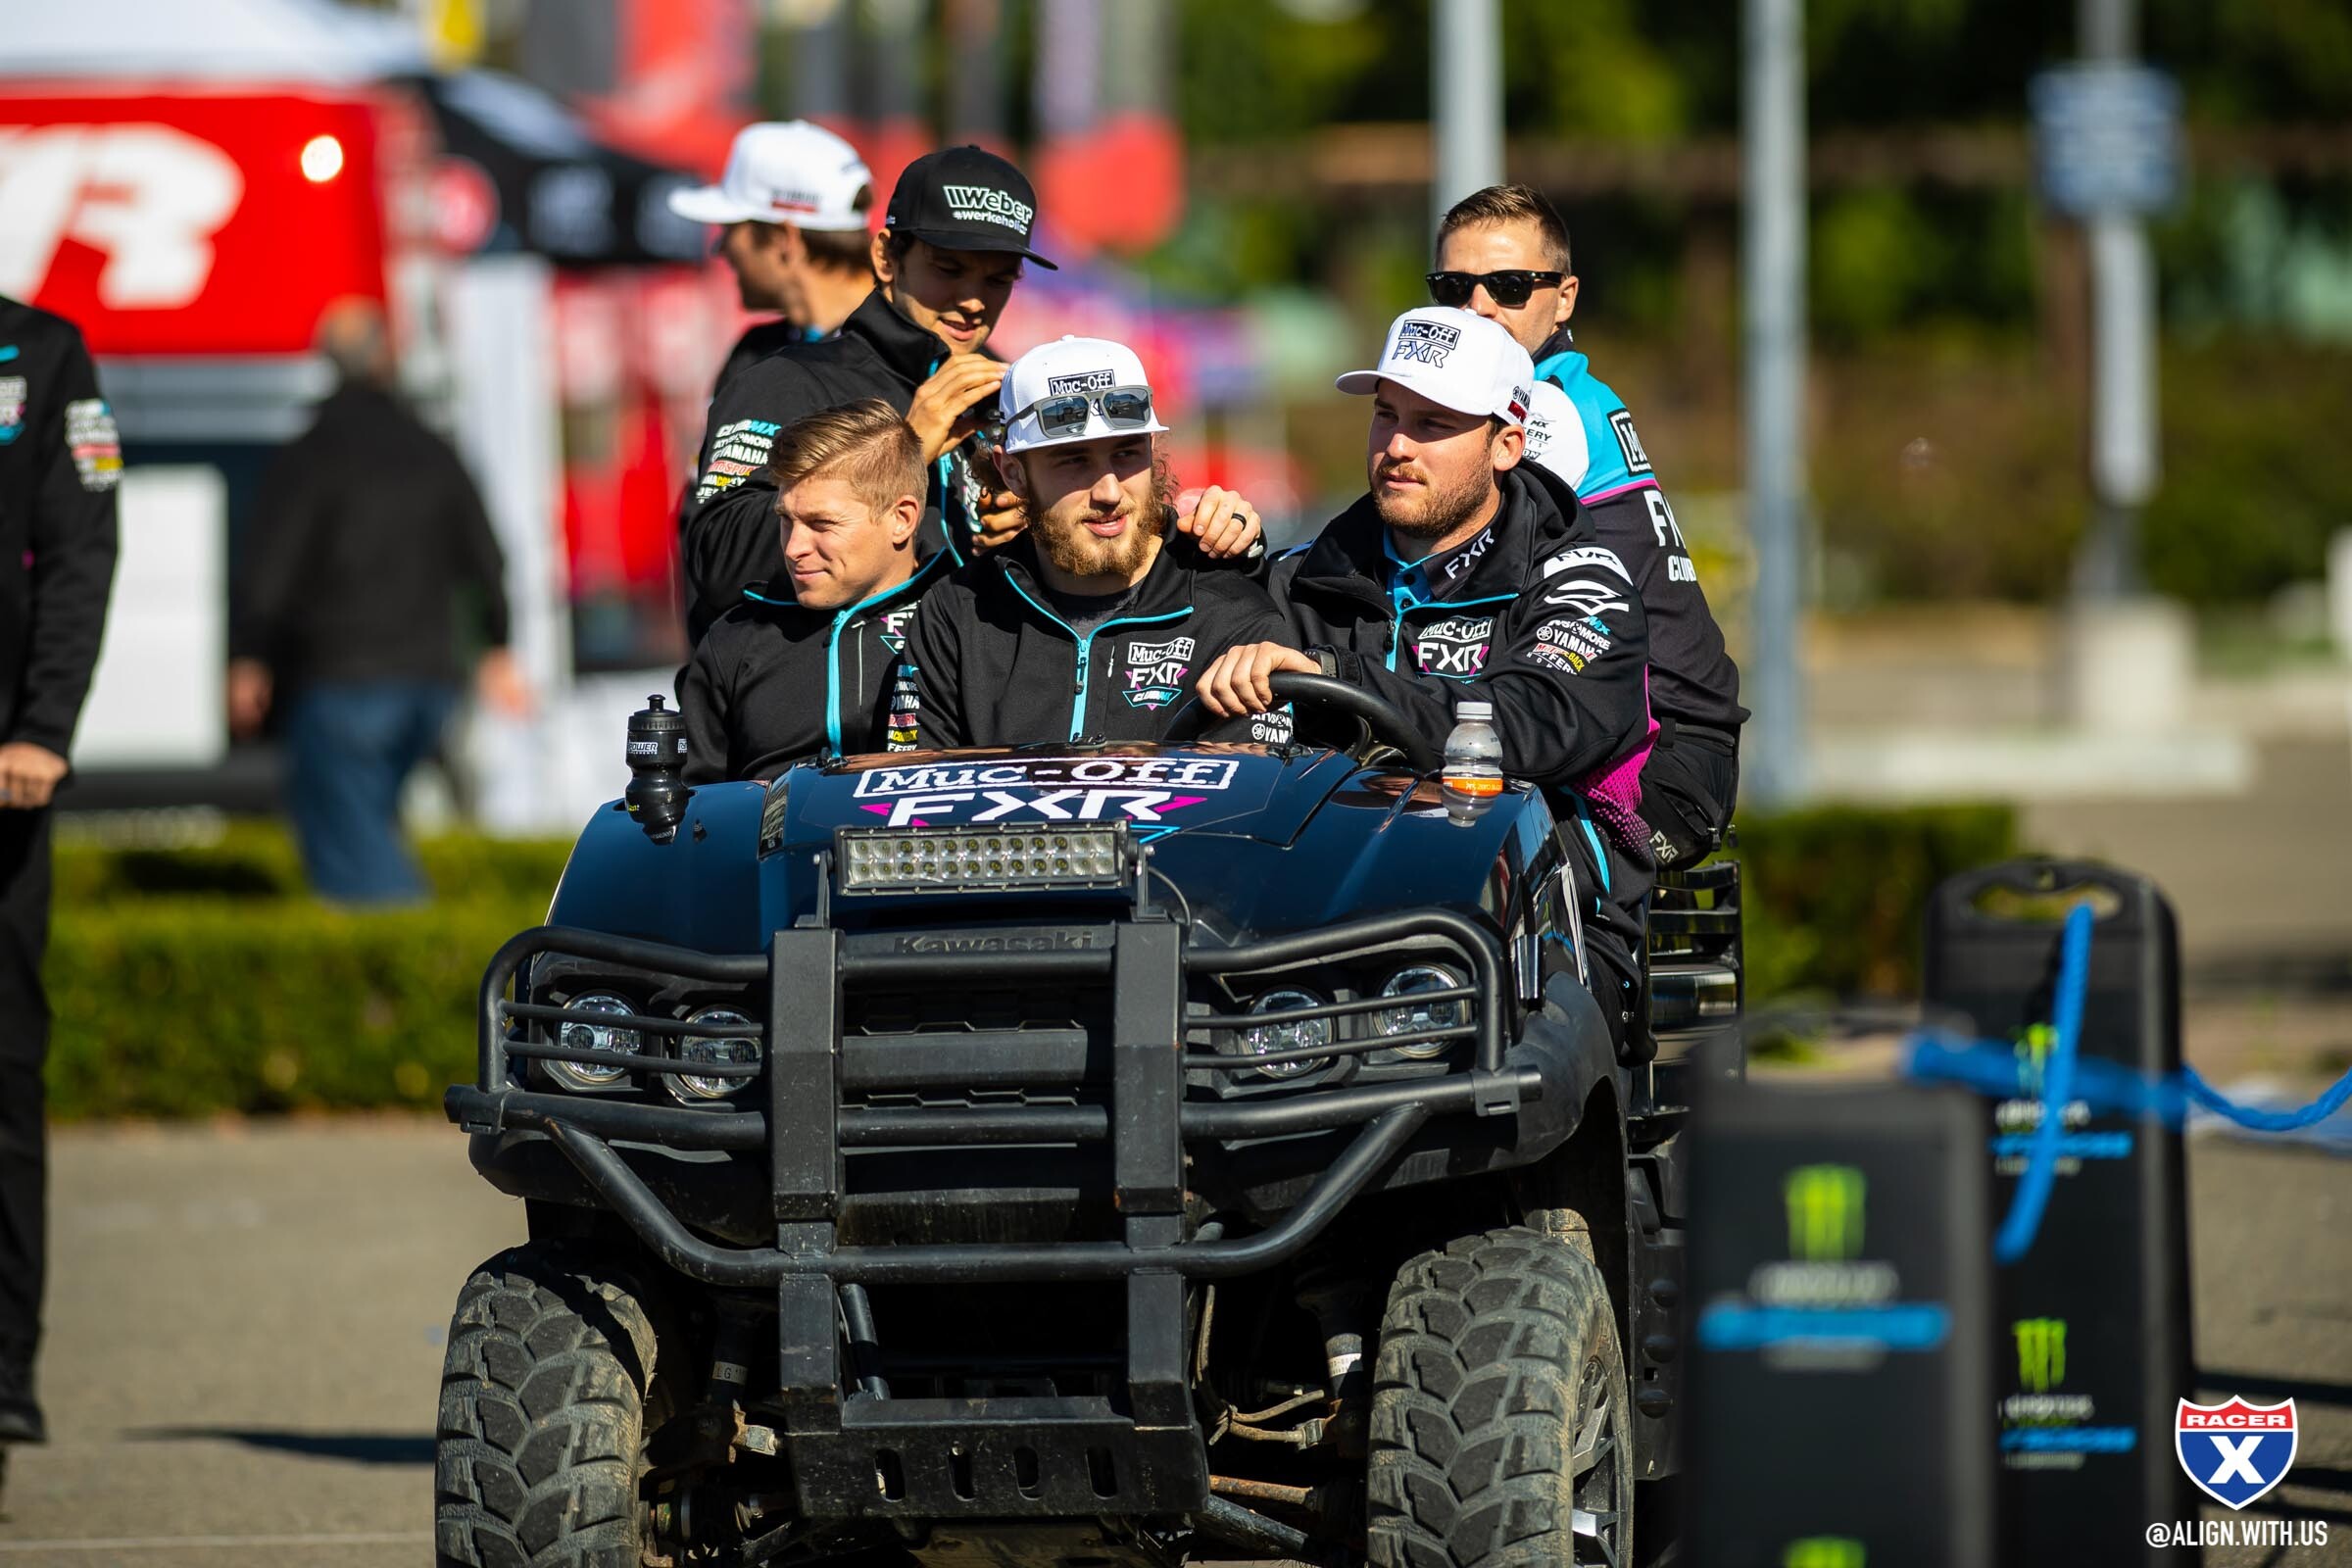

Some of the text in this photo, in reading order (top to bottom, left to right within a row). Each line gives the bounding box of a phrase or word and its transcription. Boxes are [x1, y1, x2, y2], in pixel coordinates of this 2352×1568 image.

[1392, 340, 1449, 368] FXR
[1053, 372, 1111, 397] Muc-Off
[1523, 427, 1552, 442] ERY
[1445, 527, 1495, 580] FXR
[1131, 640, 1191, 662] Muc-Off
[1418, 641, 1484, 673] FXR
[1129, 662, 1183, 689] FXR
[880, 760, 1221, 793] Muc-Off
[887, 789, 1173, 827] FXR
[1649, 829, 1679, 863] FXR
[894, 932, 1093, 954] Kawasaki
